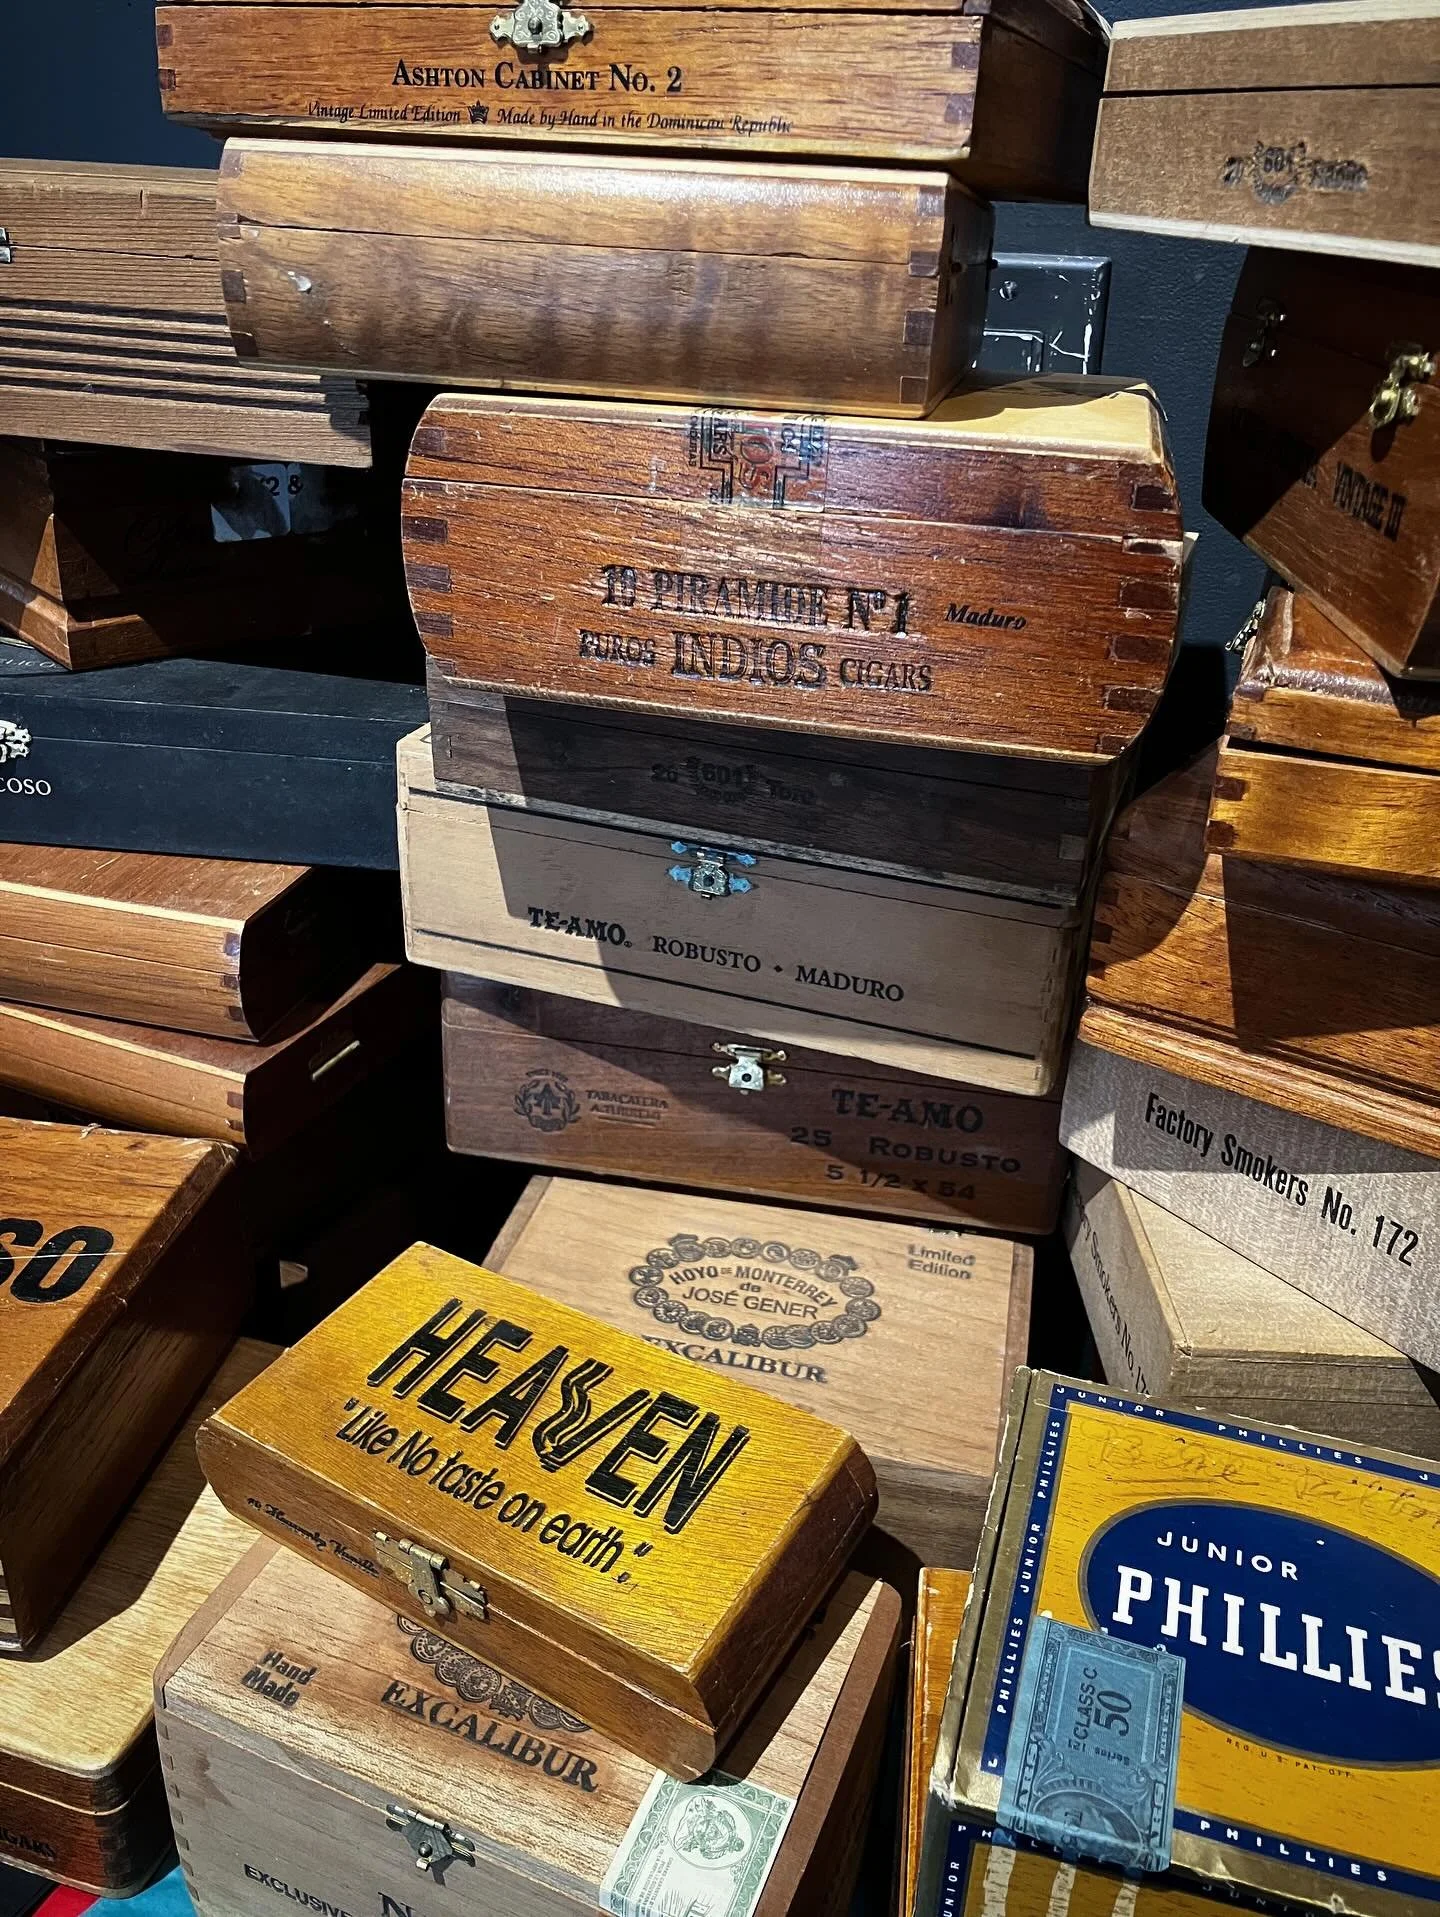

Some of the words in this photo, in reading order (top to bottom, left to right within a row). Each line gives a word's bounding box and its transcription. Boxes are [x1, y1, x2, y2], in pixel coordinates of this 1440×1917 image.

[391, 58, 485, 88] ASHTON
[494, 61, 599, 91] CABINET
[666, 65, 682, 92] 2
[308, 101, 354, 124] Vintage
[358, 103, 408, 122] Limited
[411, 104, 461, 123] Edition
[497, 107, 536, 125] Made
[539, 110, 556, 130] by
[558, 110, 598, 127] Hand
[602, 112, 616, 127] in
[621, 110, 641, 128] the
[646, 112, 724, 130] Dominican
[944, 602, 1028, 631] Maduro
[671, 630, 830, 690] INDIOS
[839, 657, 933, 693] CIGARS
[652, 935, 762, 974] ROBUSTO
[795, 964, 905, 1002] MADURO
[831, 1088, 984, 1134] TE-AMO
[790, 1126, 832, 1147] 25
[869, 1136, 1022, 1173] ROBUSTO
[825, 1164, 845, 1181] 5
[859, 1167, 902, 1189] 1/2
[941, 1181, 976, 1200] 54
[1144, 1091, 1214, 1158] Factory
[1220, 1133, 1310, 1207] Smokers
[1319, 1185, 1357, 1236] No.
[1371, 1213, 1421, 1267] 172
[907, 1243, 977, 1266] Limited
[908, 1258, 972, 1280] Edition
[669, 1265, 719, 1286] HOYO
[734, 1265, 838, 1308] MONTERREY
[682, 1286, 739, 1307] JOSÉ
[743, 1295, 818, 1320] GENER
[739, 1281, 762, 1293] de
[366, 1296, 751, 1534] HEAVEN
[1056, 1387, 1165, 1417] JUNIOR
[1217, 1424, 1362, 1465] PHILLIES
[386, 1428, 441, 1477] No
[429, 1449, 504, 1511] taste
[497, 1491, 548, 1533] on
[1037, 1421, 1061, 1499] PHILLIES
[1020, 1523, 1041, 1594] JUNIOR
[1157, 1530, 1300, 1581] JUNIOR
[1111, 1564, 1440, 1710] PHILLIE
[240, 1666, 301, 1708] Made
[261, 1650, 318, 1686] Hand
[996, 1617, 1024, 1714] PHILLIES
[1083, 1666, 1098, 1680] C
[1073, 1682, 1096, 1740] CLASS
[1093, 1690, 1132, 1737] 50
[381, 1679, 600, 1793] EXCALIBUR
[1200, 1819, 1388, 1883] PHILLIES
